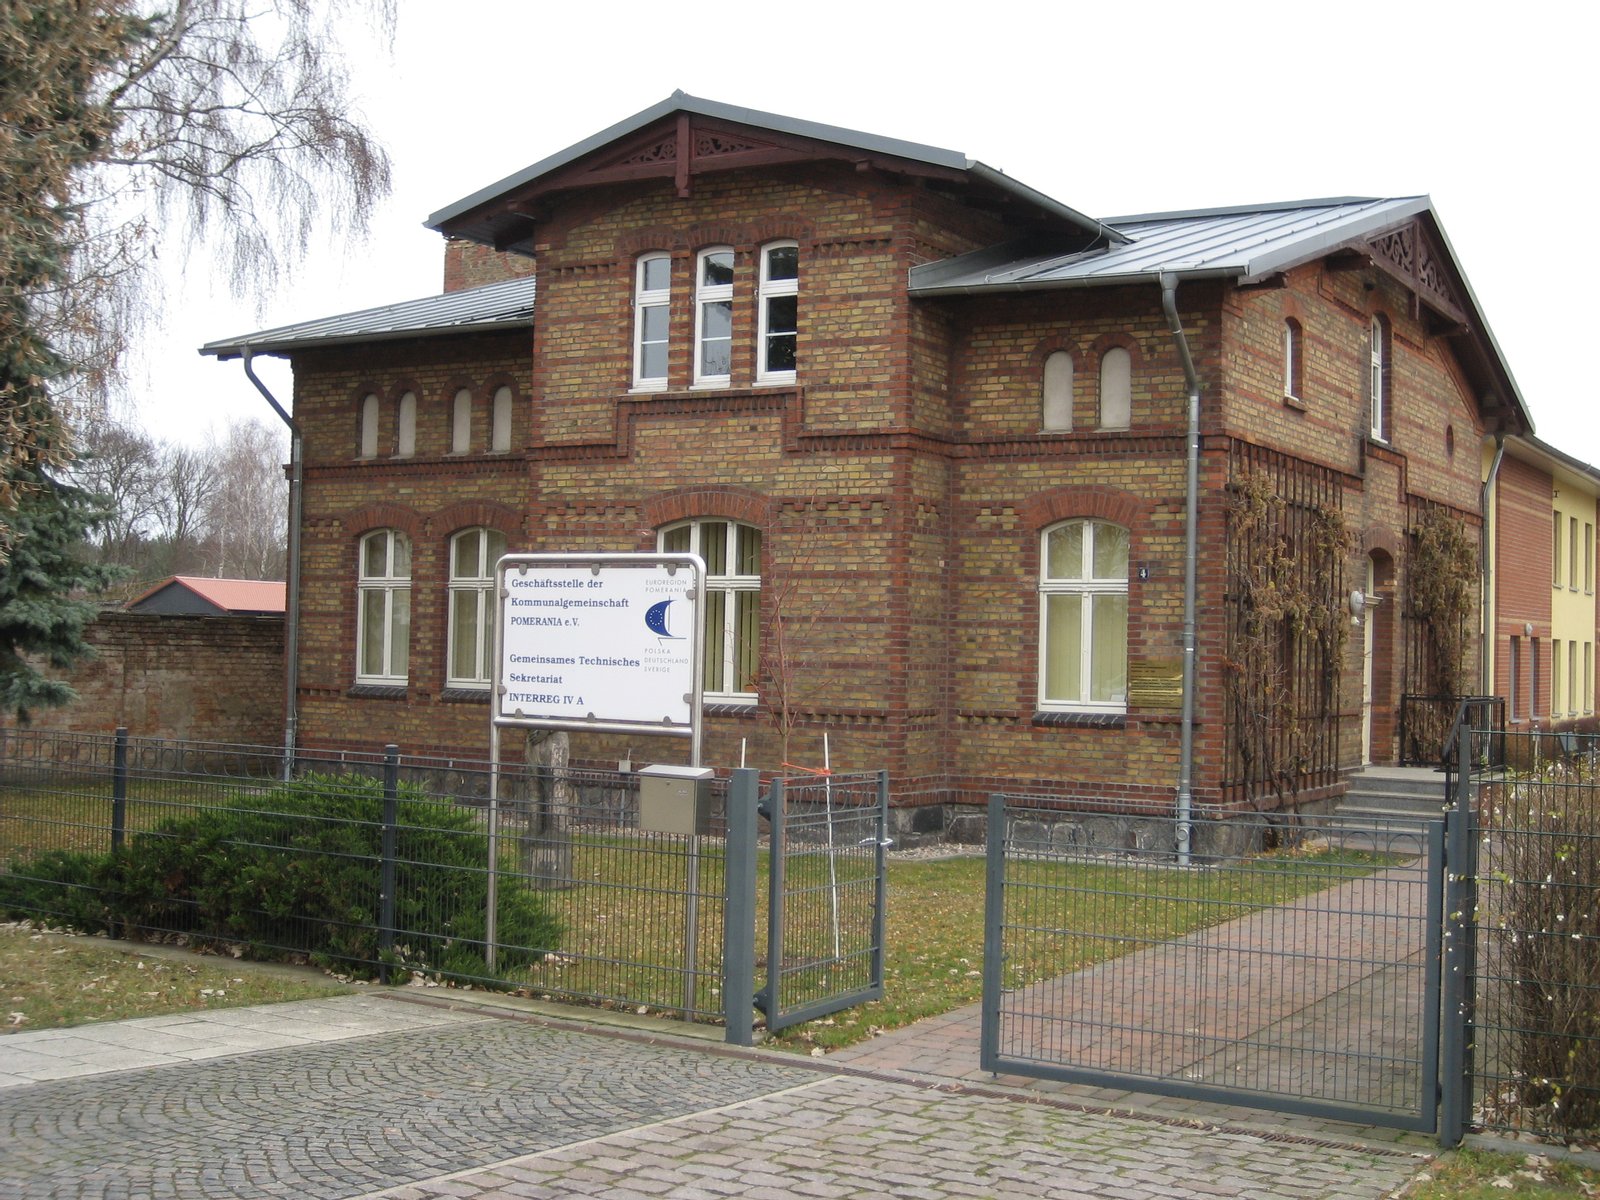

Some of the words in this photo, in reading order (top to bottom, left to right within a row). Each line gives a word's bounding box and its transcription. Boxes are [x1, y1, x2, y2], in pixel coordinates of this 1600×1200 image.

[1140, 569, 1146, 578] 4
[511, 579, 584, 589] Geschäftsstelle
[587, 579, 603, 589] der
[511, 597, 629, 610] Kommunalgemeinschaft
[510, 616, 562, 627] POMERANIA
[564, 617, 580, 627] e.V.
[509, 654, 575, 665] Gemeinsames
[579, 656, 640, 667] Technisches
[644, 657, 689, 665] DEUTSCHLAND
[509, 673, 563, 684] Sekretariat
[509, 693, 561, 704] INTERREG
[563, 695, 574, 705] IV
[576, 696, 584, 705] A
